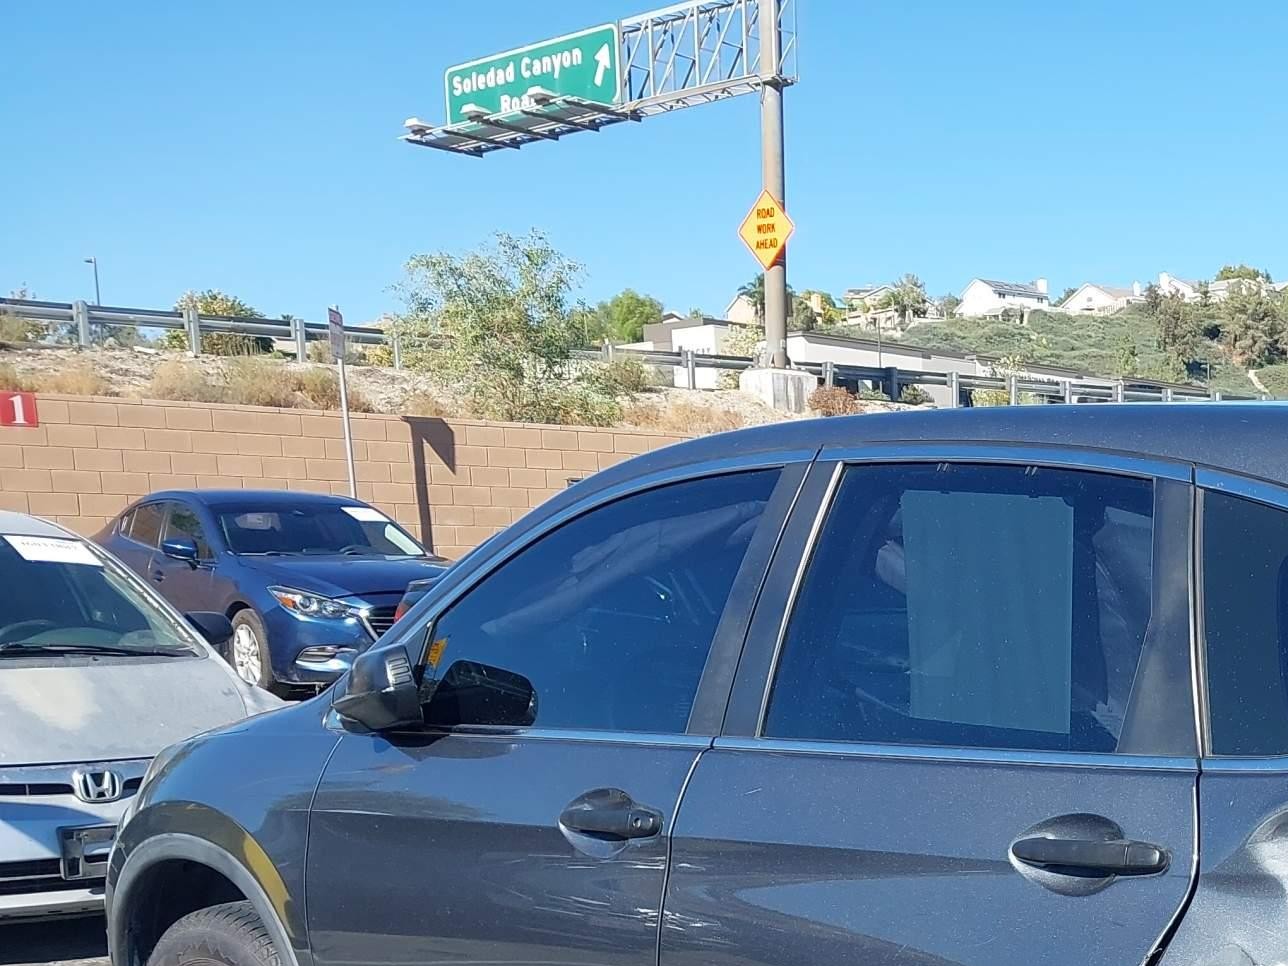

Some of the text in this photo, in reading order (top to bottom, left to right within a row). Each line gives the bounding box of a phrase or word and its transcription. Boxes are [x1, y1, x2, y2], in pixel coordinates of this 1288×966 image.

[452, 47, 583, 96] Soledad Canyon
[500, 94, 535, 113] Roa
[756, 207, 775, 219] ROAD
[756, 223, 776, 234] WORK
[756, 238, 778, 249] AHEAD
[8, 394, 28, 424] 1
